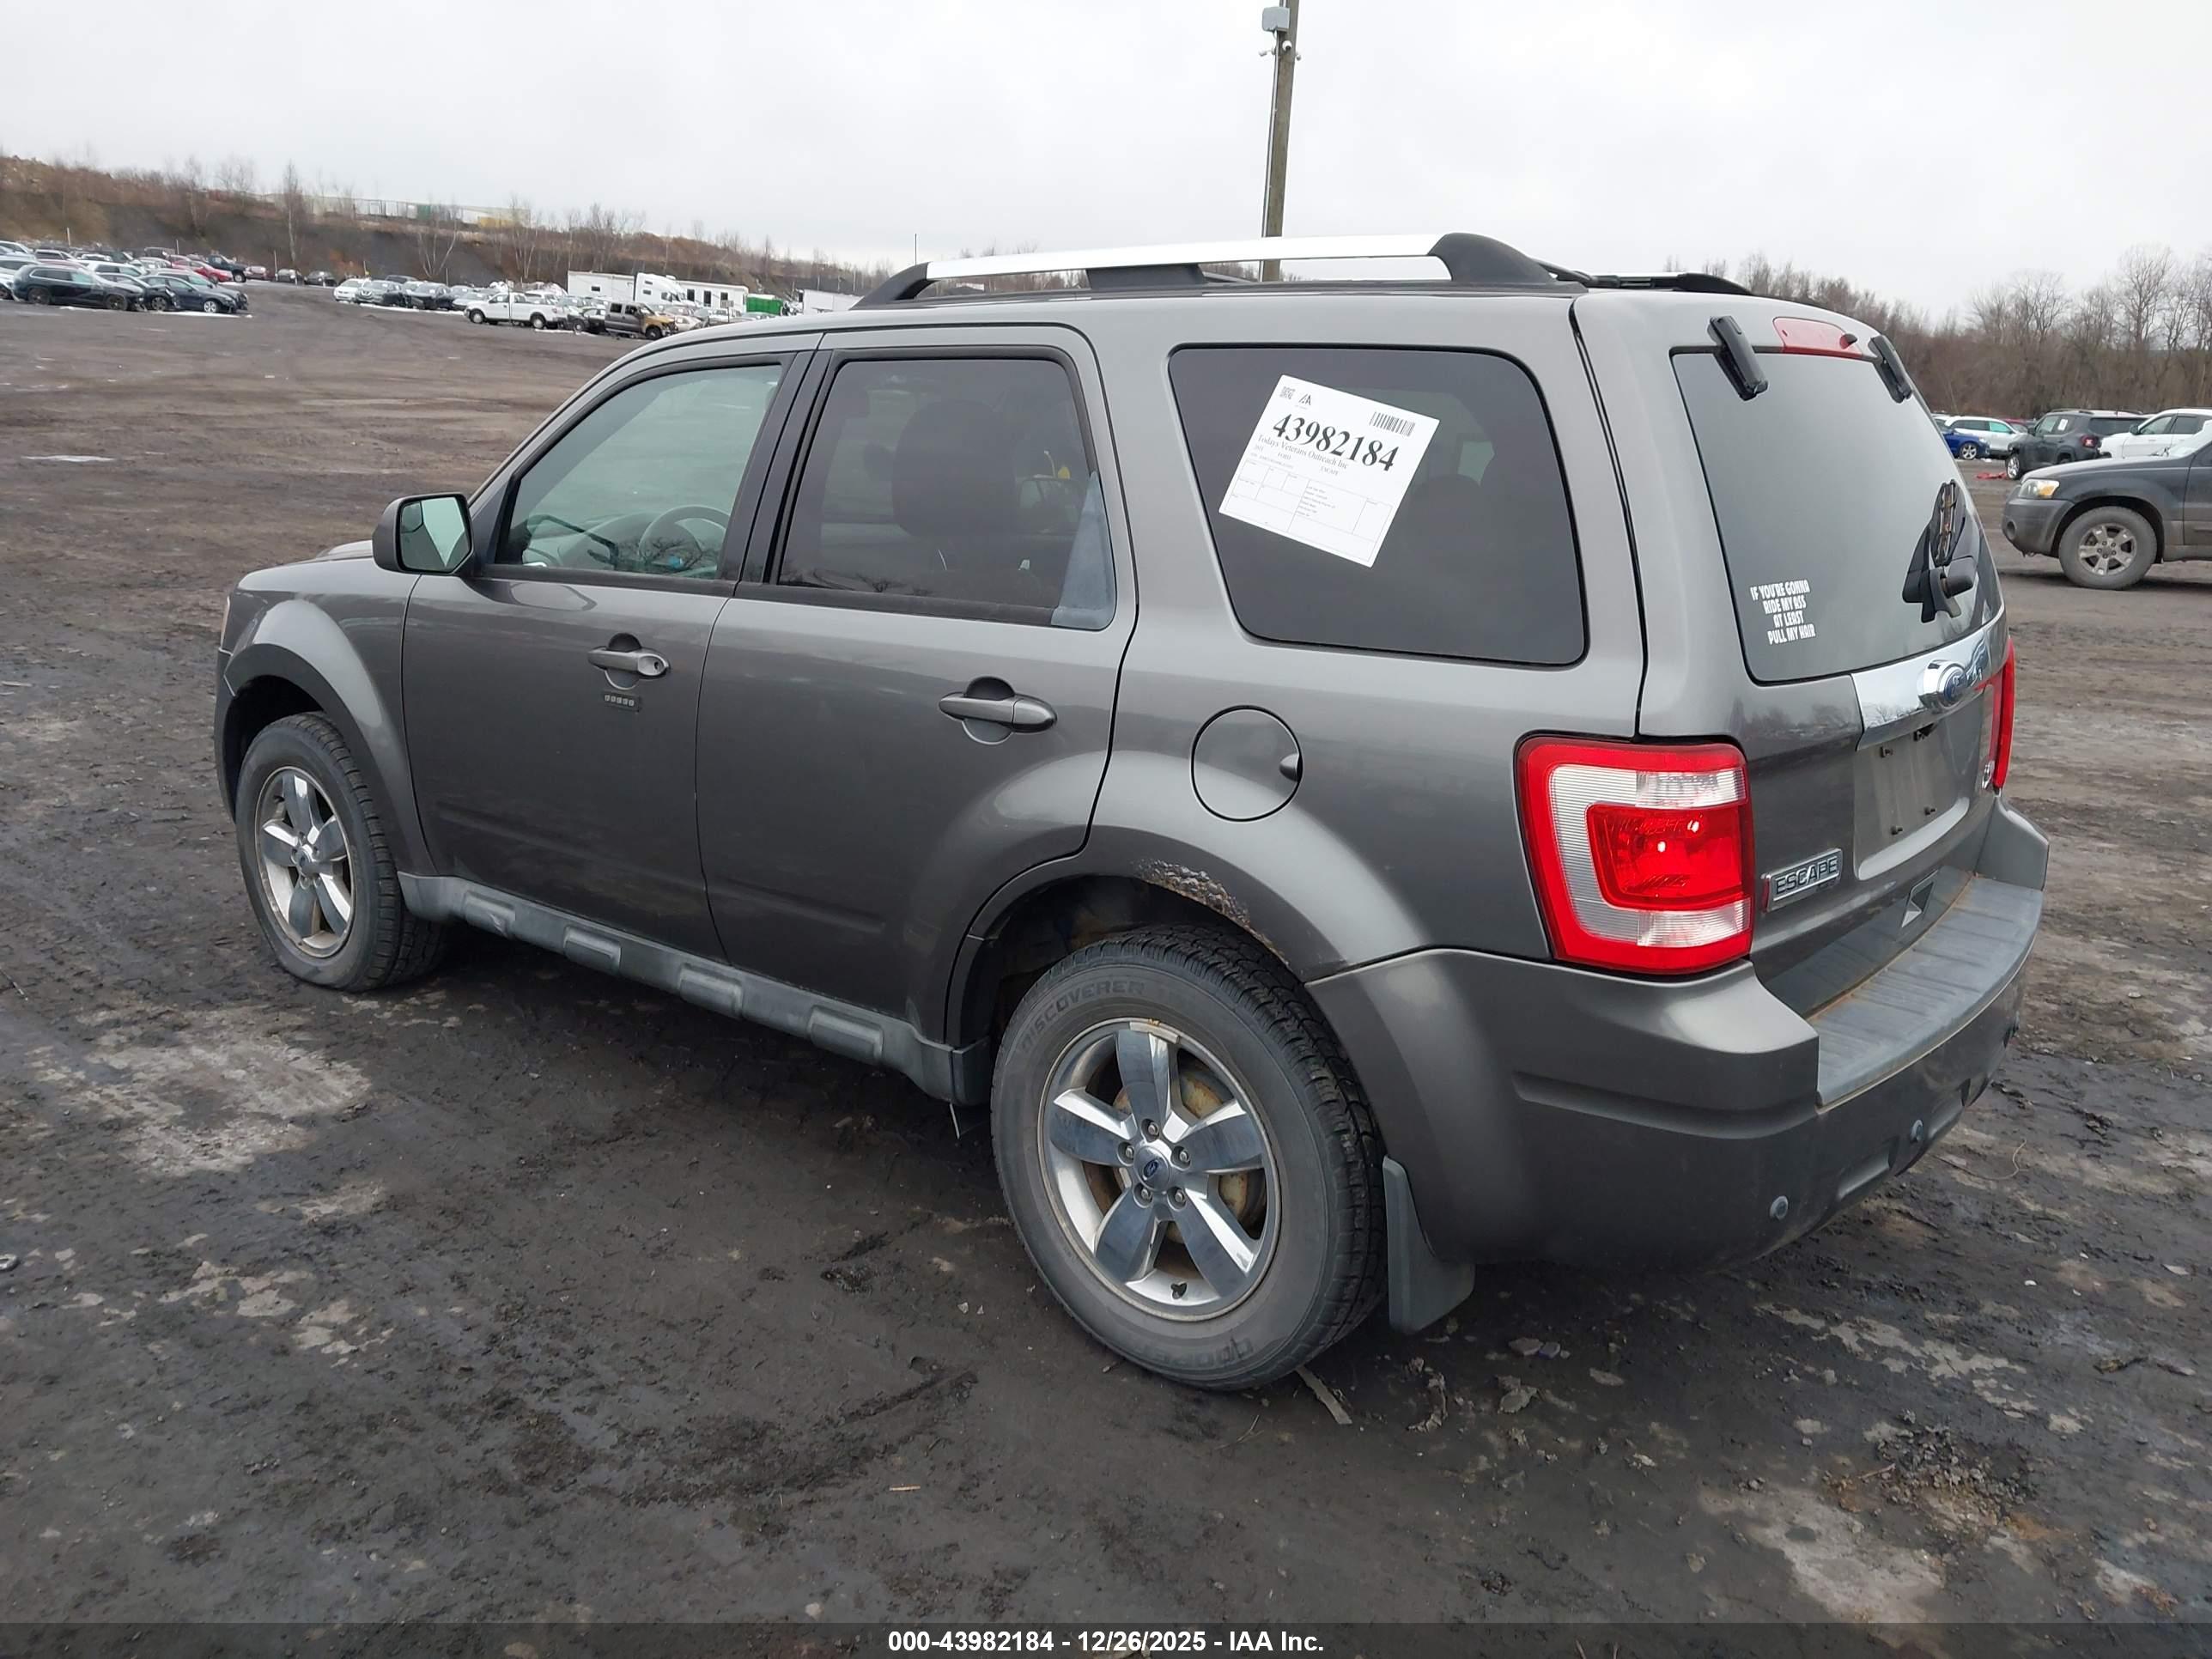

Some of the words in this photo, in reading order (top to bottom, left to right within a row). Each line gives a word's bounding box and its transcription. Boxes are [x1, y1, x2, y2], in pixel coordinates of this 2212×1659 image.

[1258, 434, 1279, 447] Todays
[1281, 440, 1307, 456] Veterans
[1308, 450, 1338, 466] Outreach
[1273, 414, 1400, 471] 43982184
[1750, 586, 1759, 601] IF
[1784, 579, 1810, 596] GONNA
[1763, 598, 1782, 615] RIDE
[1780, 596, 1793, 612] MY
[1793, 594, 1807, 610] ASS
[1773, 613, 1784, 629] AT
[1784, 610, 1804, 627] LEAST
[1767, 629, 1787, 645] PULL
[1786, 626, 1799, 641] MY
[1799, 623, 1816, 639] HAIR
[1775, 856, 1838, 894] ESCAPE
[1020, 980, 1146, 1053] DISCOVERER
